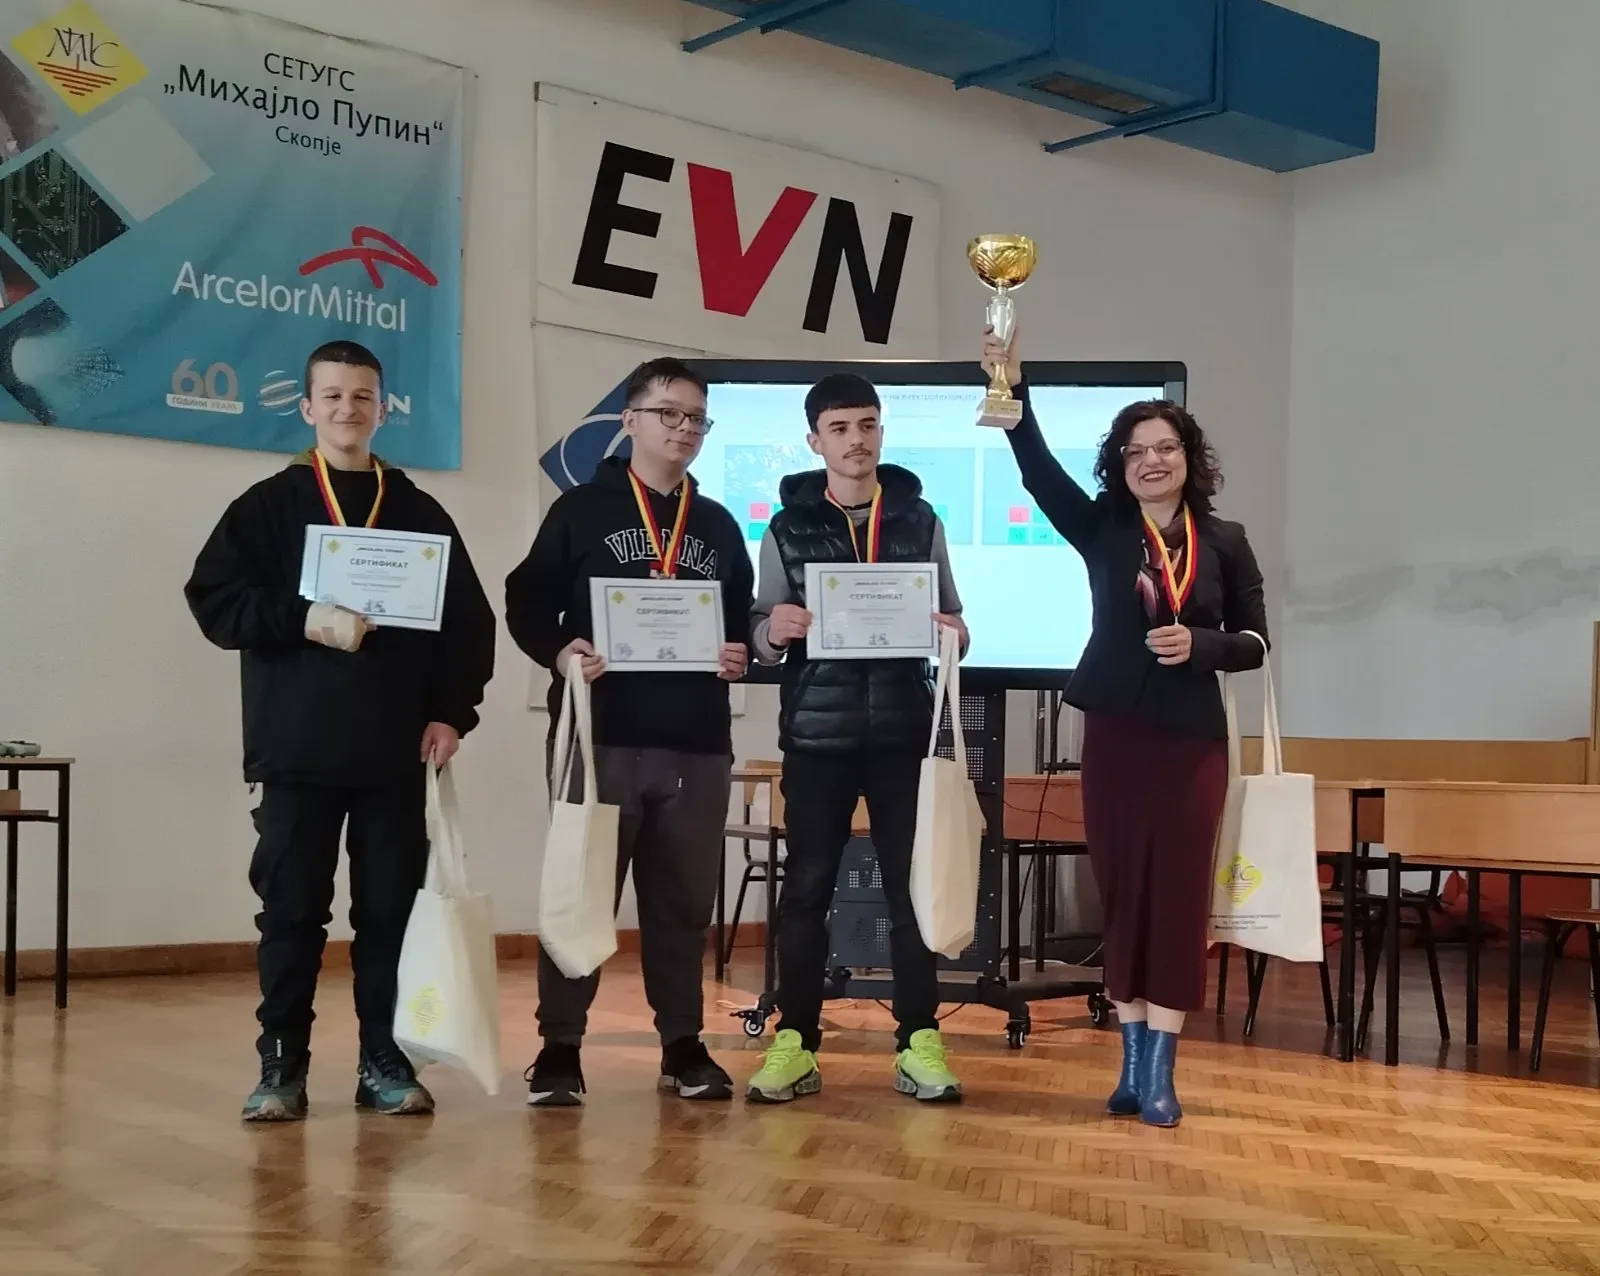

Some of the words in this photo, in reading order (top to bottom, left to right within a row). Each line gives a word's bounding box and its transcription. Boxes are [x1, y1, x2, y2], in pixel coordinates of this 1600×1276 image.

[163, 64, 320, 120] „Михајло
[263, 52, 356, 92] СЕТУГС
[275, 125, 342, 156] Скопје
[572, 141, 913, 345] EVN
[172, 261, 406, 332] ArcelorMittal
[172, 360, 237, 400] 60
[349, 558, 409, 569] СЕРТИФИКАТ
